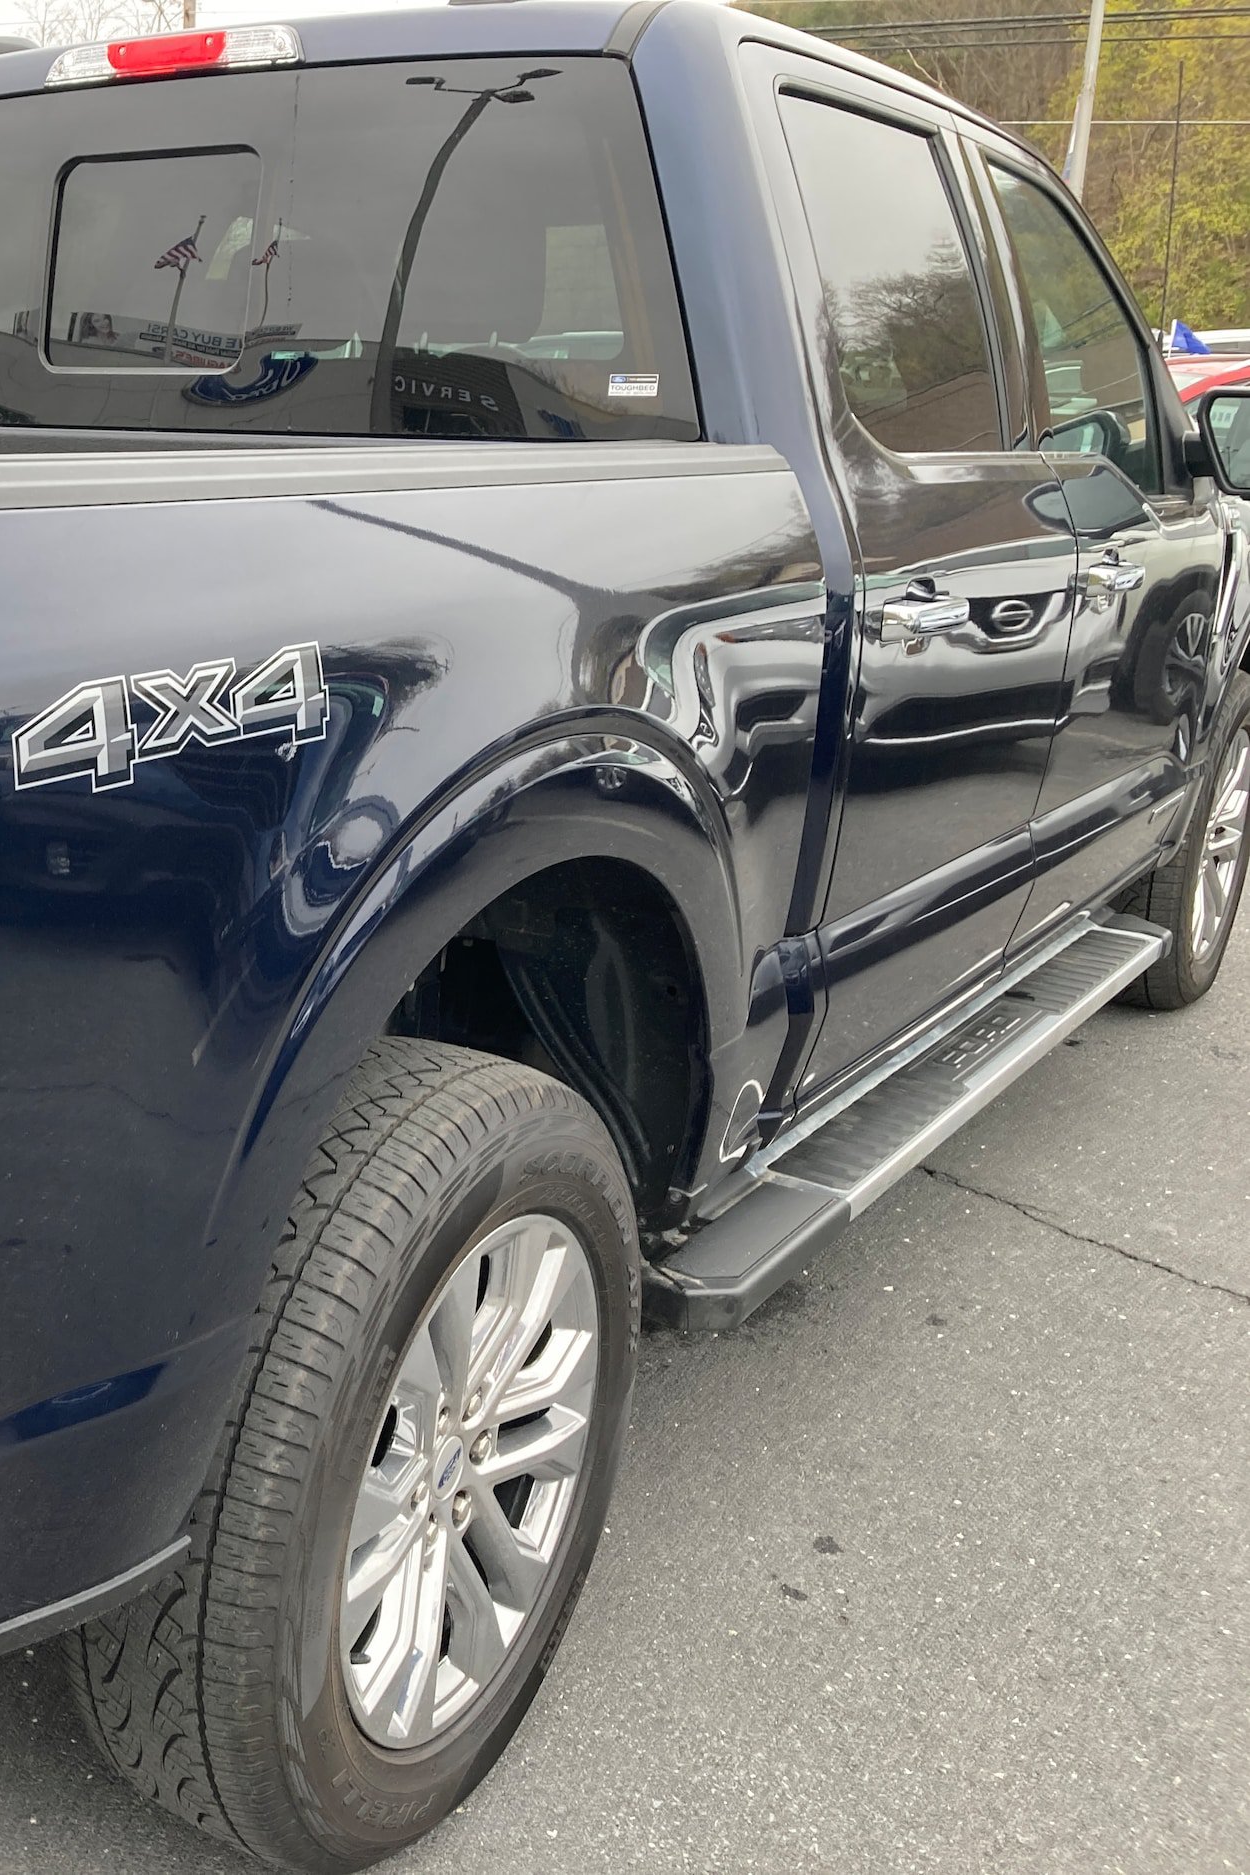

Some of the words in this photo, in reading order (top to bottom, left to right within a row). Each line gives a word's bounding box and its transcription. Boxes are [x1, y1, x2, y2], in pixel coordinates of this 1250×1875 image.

[933, 1014, 1022, 1069] FORD
[520, 1149, 634, 1246] SCORPION
[330, 1767, 438, 1829] PIRELLI
